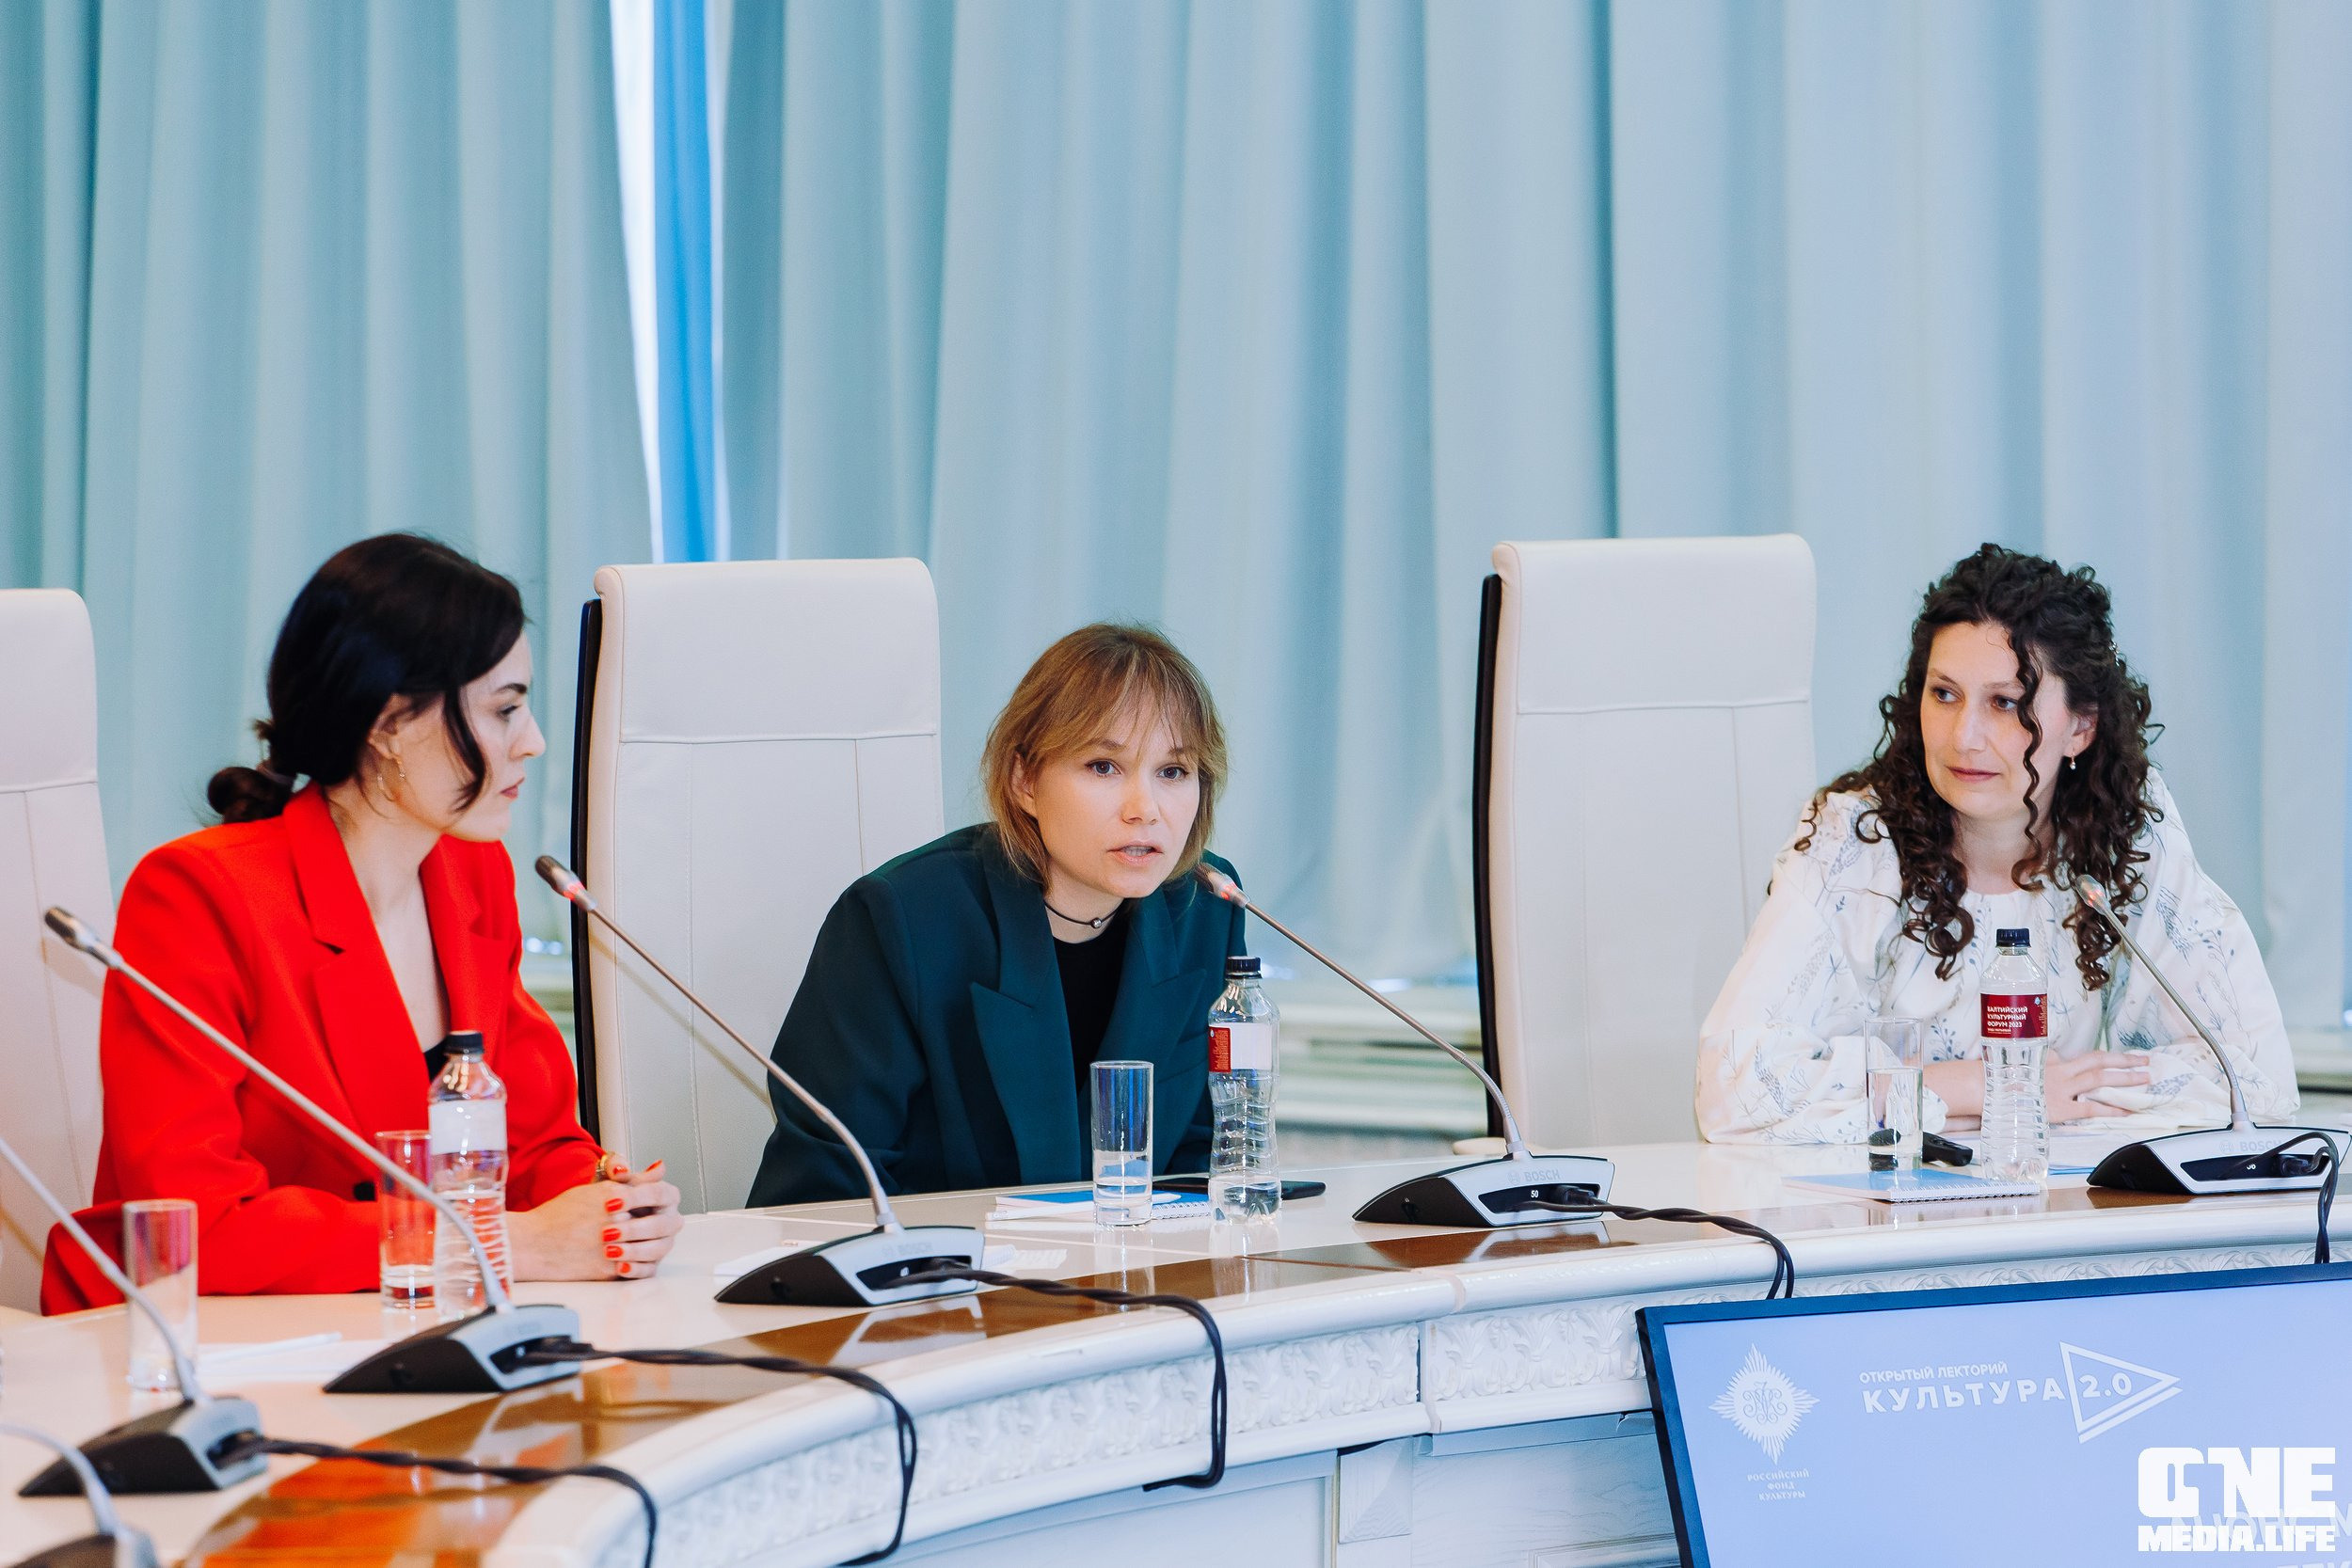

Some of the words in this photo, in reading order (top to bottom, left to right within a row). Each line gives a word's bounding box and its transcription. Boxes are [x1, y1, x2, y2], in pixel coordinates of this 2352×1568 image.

[1524, 1169, 1561, 1182] BOSCH
[1531, 1190, 1539, 1198] 50
[1859, 1365, 1935, 1385] ОТКРЫТЫЙ
[1937, 1360, 2009, 1380] ЛЕКТОРИЙ
[1862, 1377, 2067, 1414] КУЛЬТУРА
[2078, 1371, 2133, 1399] 2.0
[1746, 1468, 1810, 1482] РОССИЙСКИЙ
[1767, 1481, 1796, 1491] ФОНД
[1757, 1490, 1807, 1502] КУЛЬТУРЫ
